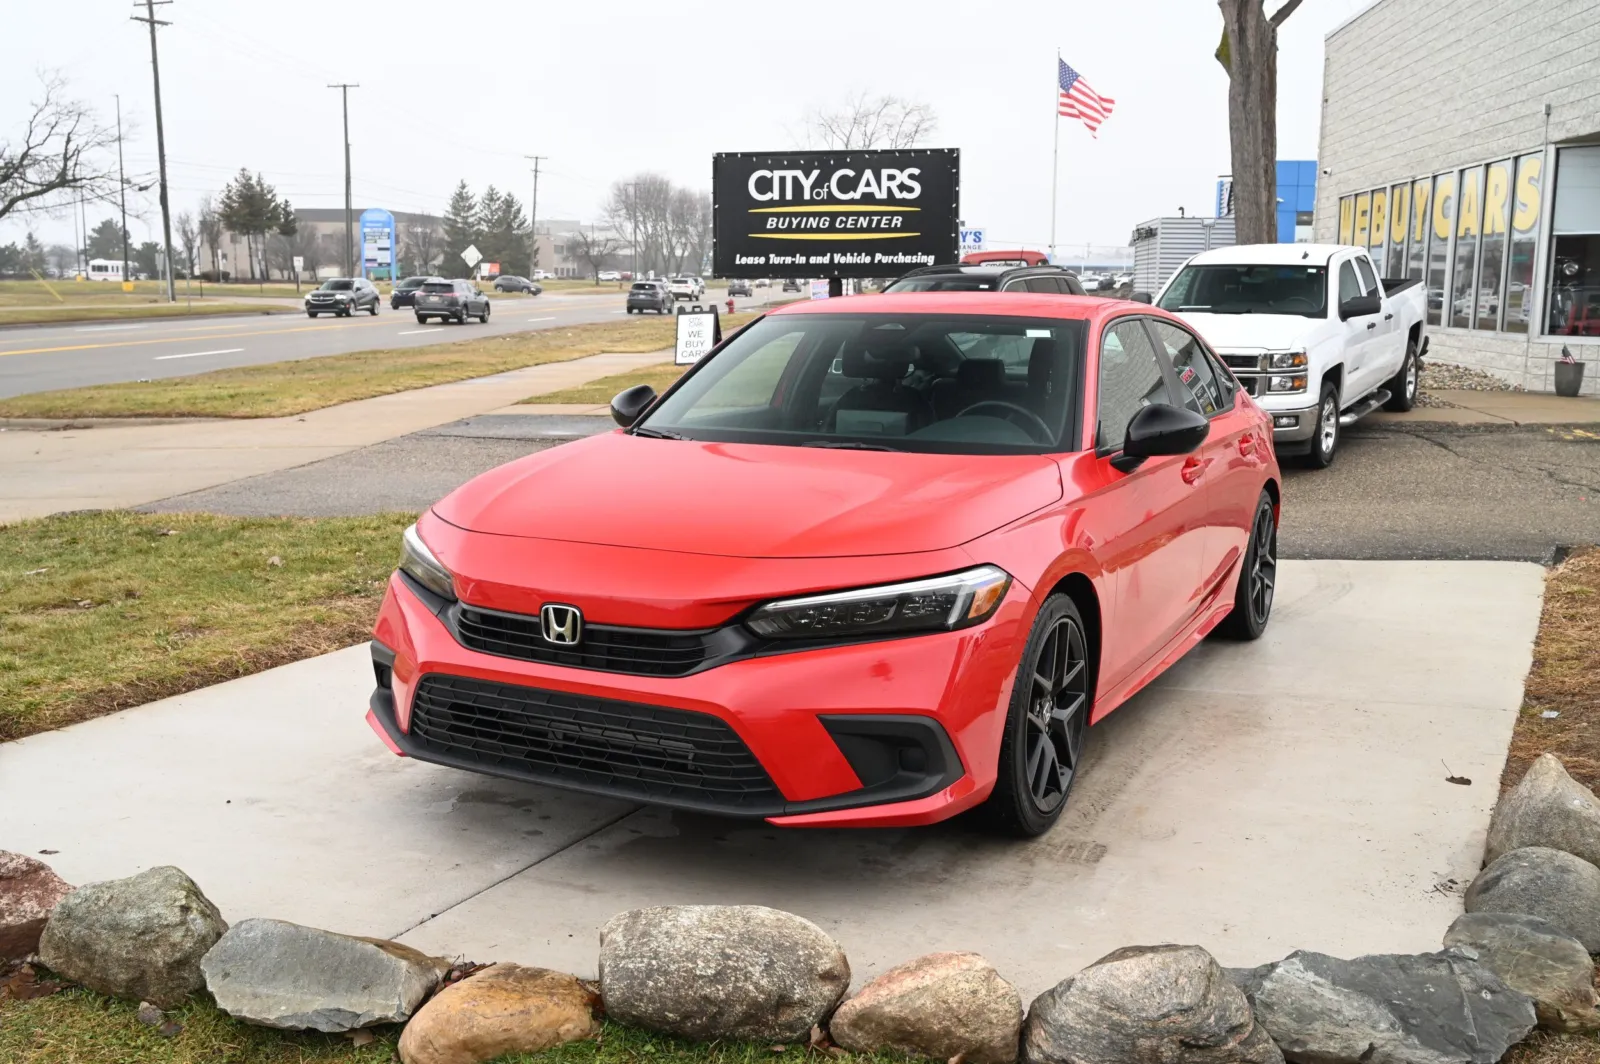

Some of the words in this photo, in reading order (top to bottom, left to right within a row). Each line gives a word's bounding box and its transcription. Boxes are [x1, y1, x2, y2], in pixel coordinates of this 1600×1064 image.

[748, 169, 820, 201] CITY
[812, 182, 830, 200] of
[829, 167, 922, 200] CARS
[766, 216, 830, 229] BUYING
[835, 215, 903, 229] CENTER
[735, 253, 766, 265] Lease
[769, 253, 806, 265] Turn-In
[809, 252, 831, 264] and
[833, 252, 871, 264] Vehicle
[874, 252, 935, 266] Purchasing
[688, 330, 704, 338] WE
[685, 340, 705, 348] BUY
